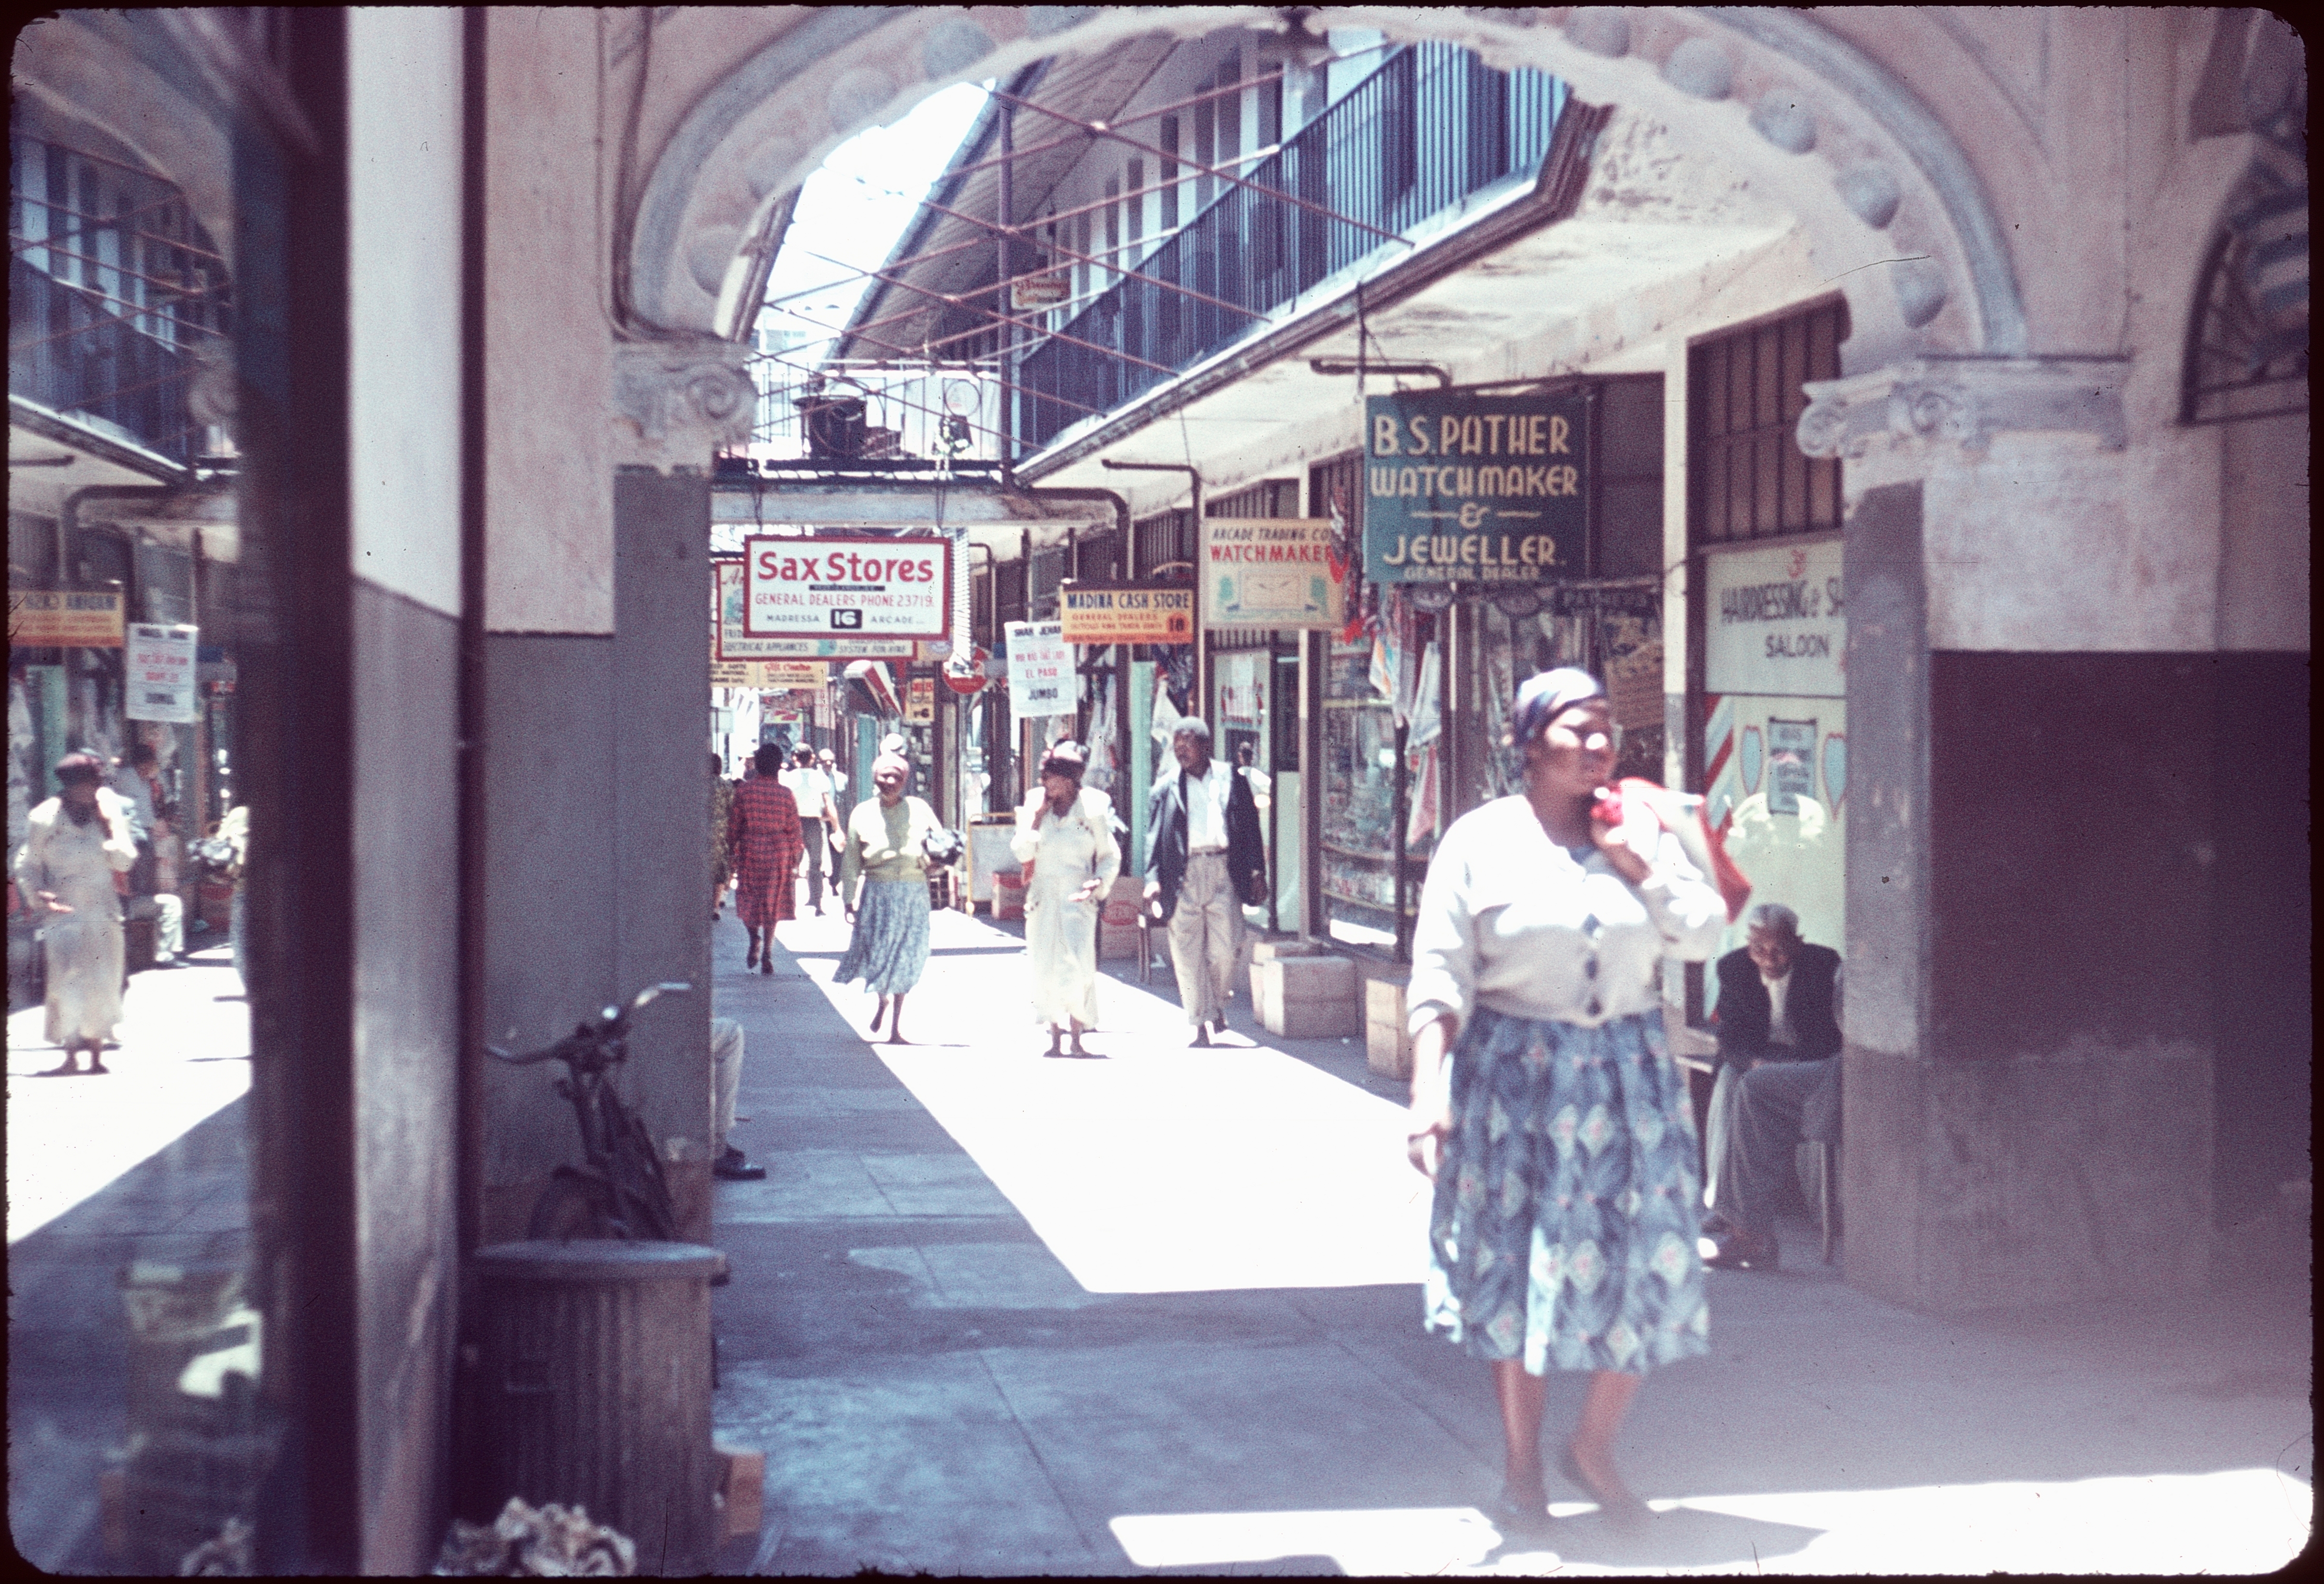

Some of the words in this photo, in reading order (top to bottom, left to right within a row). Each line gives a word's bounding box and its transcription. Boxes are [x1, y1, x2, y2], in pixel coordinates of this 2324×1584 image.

[1440, 414, 1570, 455] PATHER
[1370, 466, 1578, 497] WATCHMAKER
[1459, 501, 1491, 529] &
[1212, 528, 1253, 540] ARCADE
[1258, 527, 1306, 540] TRADING
[757, 551, 821, 582] Sax
[826, 552, 934, 582] Stores
[755, 593, 805, 605] GENERAL
[809, 594, 856, 606] DEALERS
[861, 594, 894, 607] PHONE
[1067, 593, 1112, 609] MADINA
[1118, 593, 1149, 609] CASH
[1154, 593, 1190, 609] STORE
[766, 614, 820, 622] MADRESSA
[834, 611, 858, 626] 16
[1072, 613, 1112, 621] GENERAL
[1766, 635, 1830, 659] SALOON
[1028, 687, 1058, 700] JUMBO
